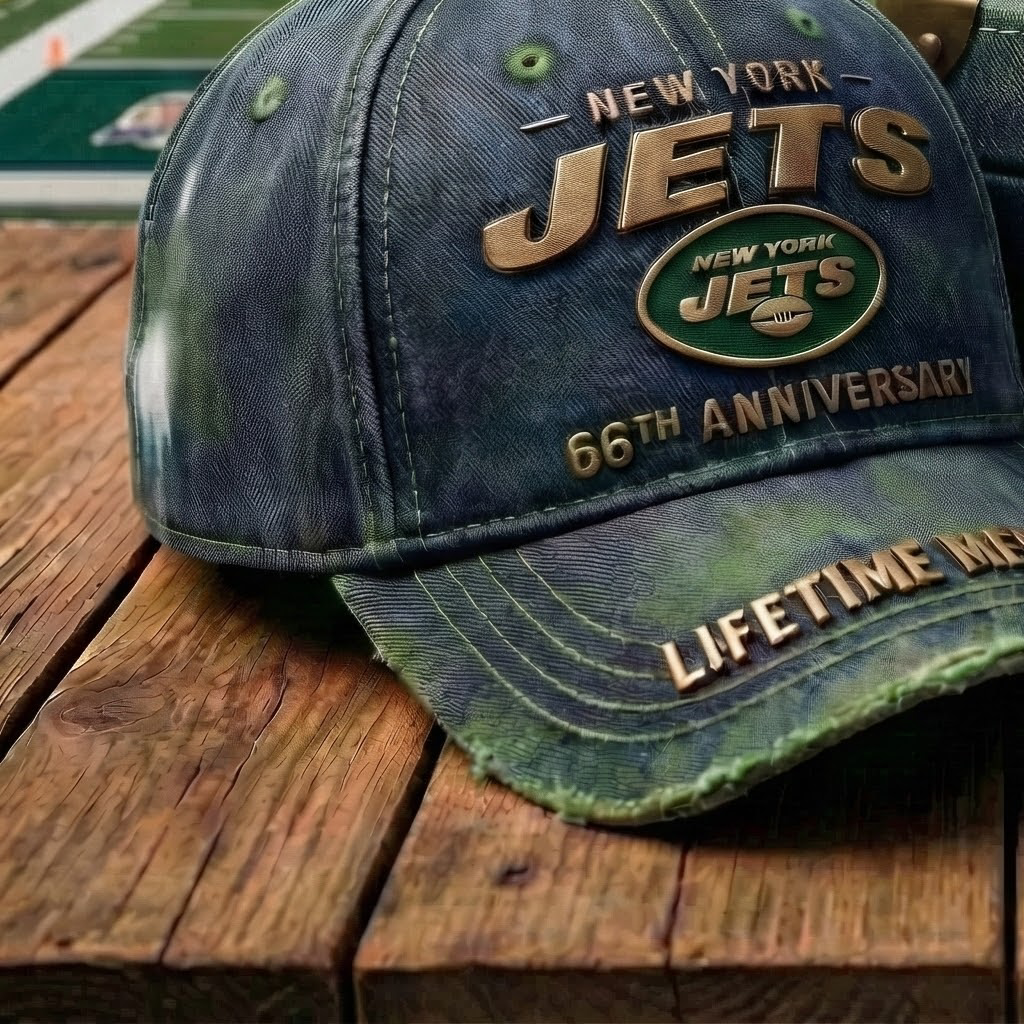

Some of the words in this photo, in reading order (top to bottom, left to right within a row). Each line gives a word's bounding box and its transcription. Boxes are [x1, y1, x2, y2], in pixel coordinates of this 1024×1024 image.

[586, 69, 695, 124] NEW
[710, 58, 833, 94] YORK
[481, 103, 934, 272] JETS
[679, 255, 856, 323] JETS
[691, 244, 760, 273] NEW
[763, 233, 837, 259] YORK
[566, 406, 681, 480] 66TH
[702, 357, 973, 444] ANNIVERSARY
[662, 537, 945, 694] LIFETIME
